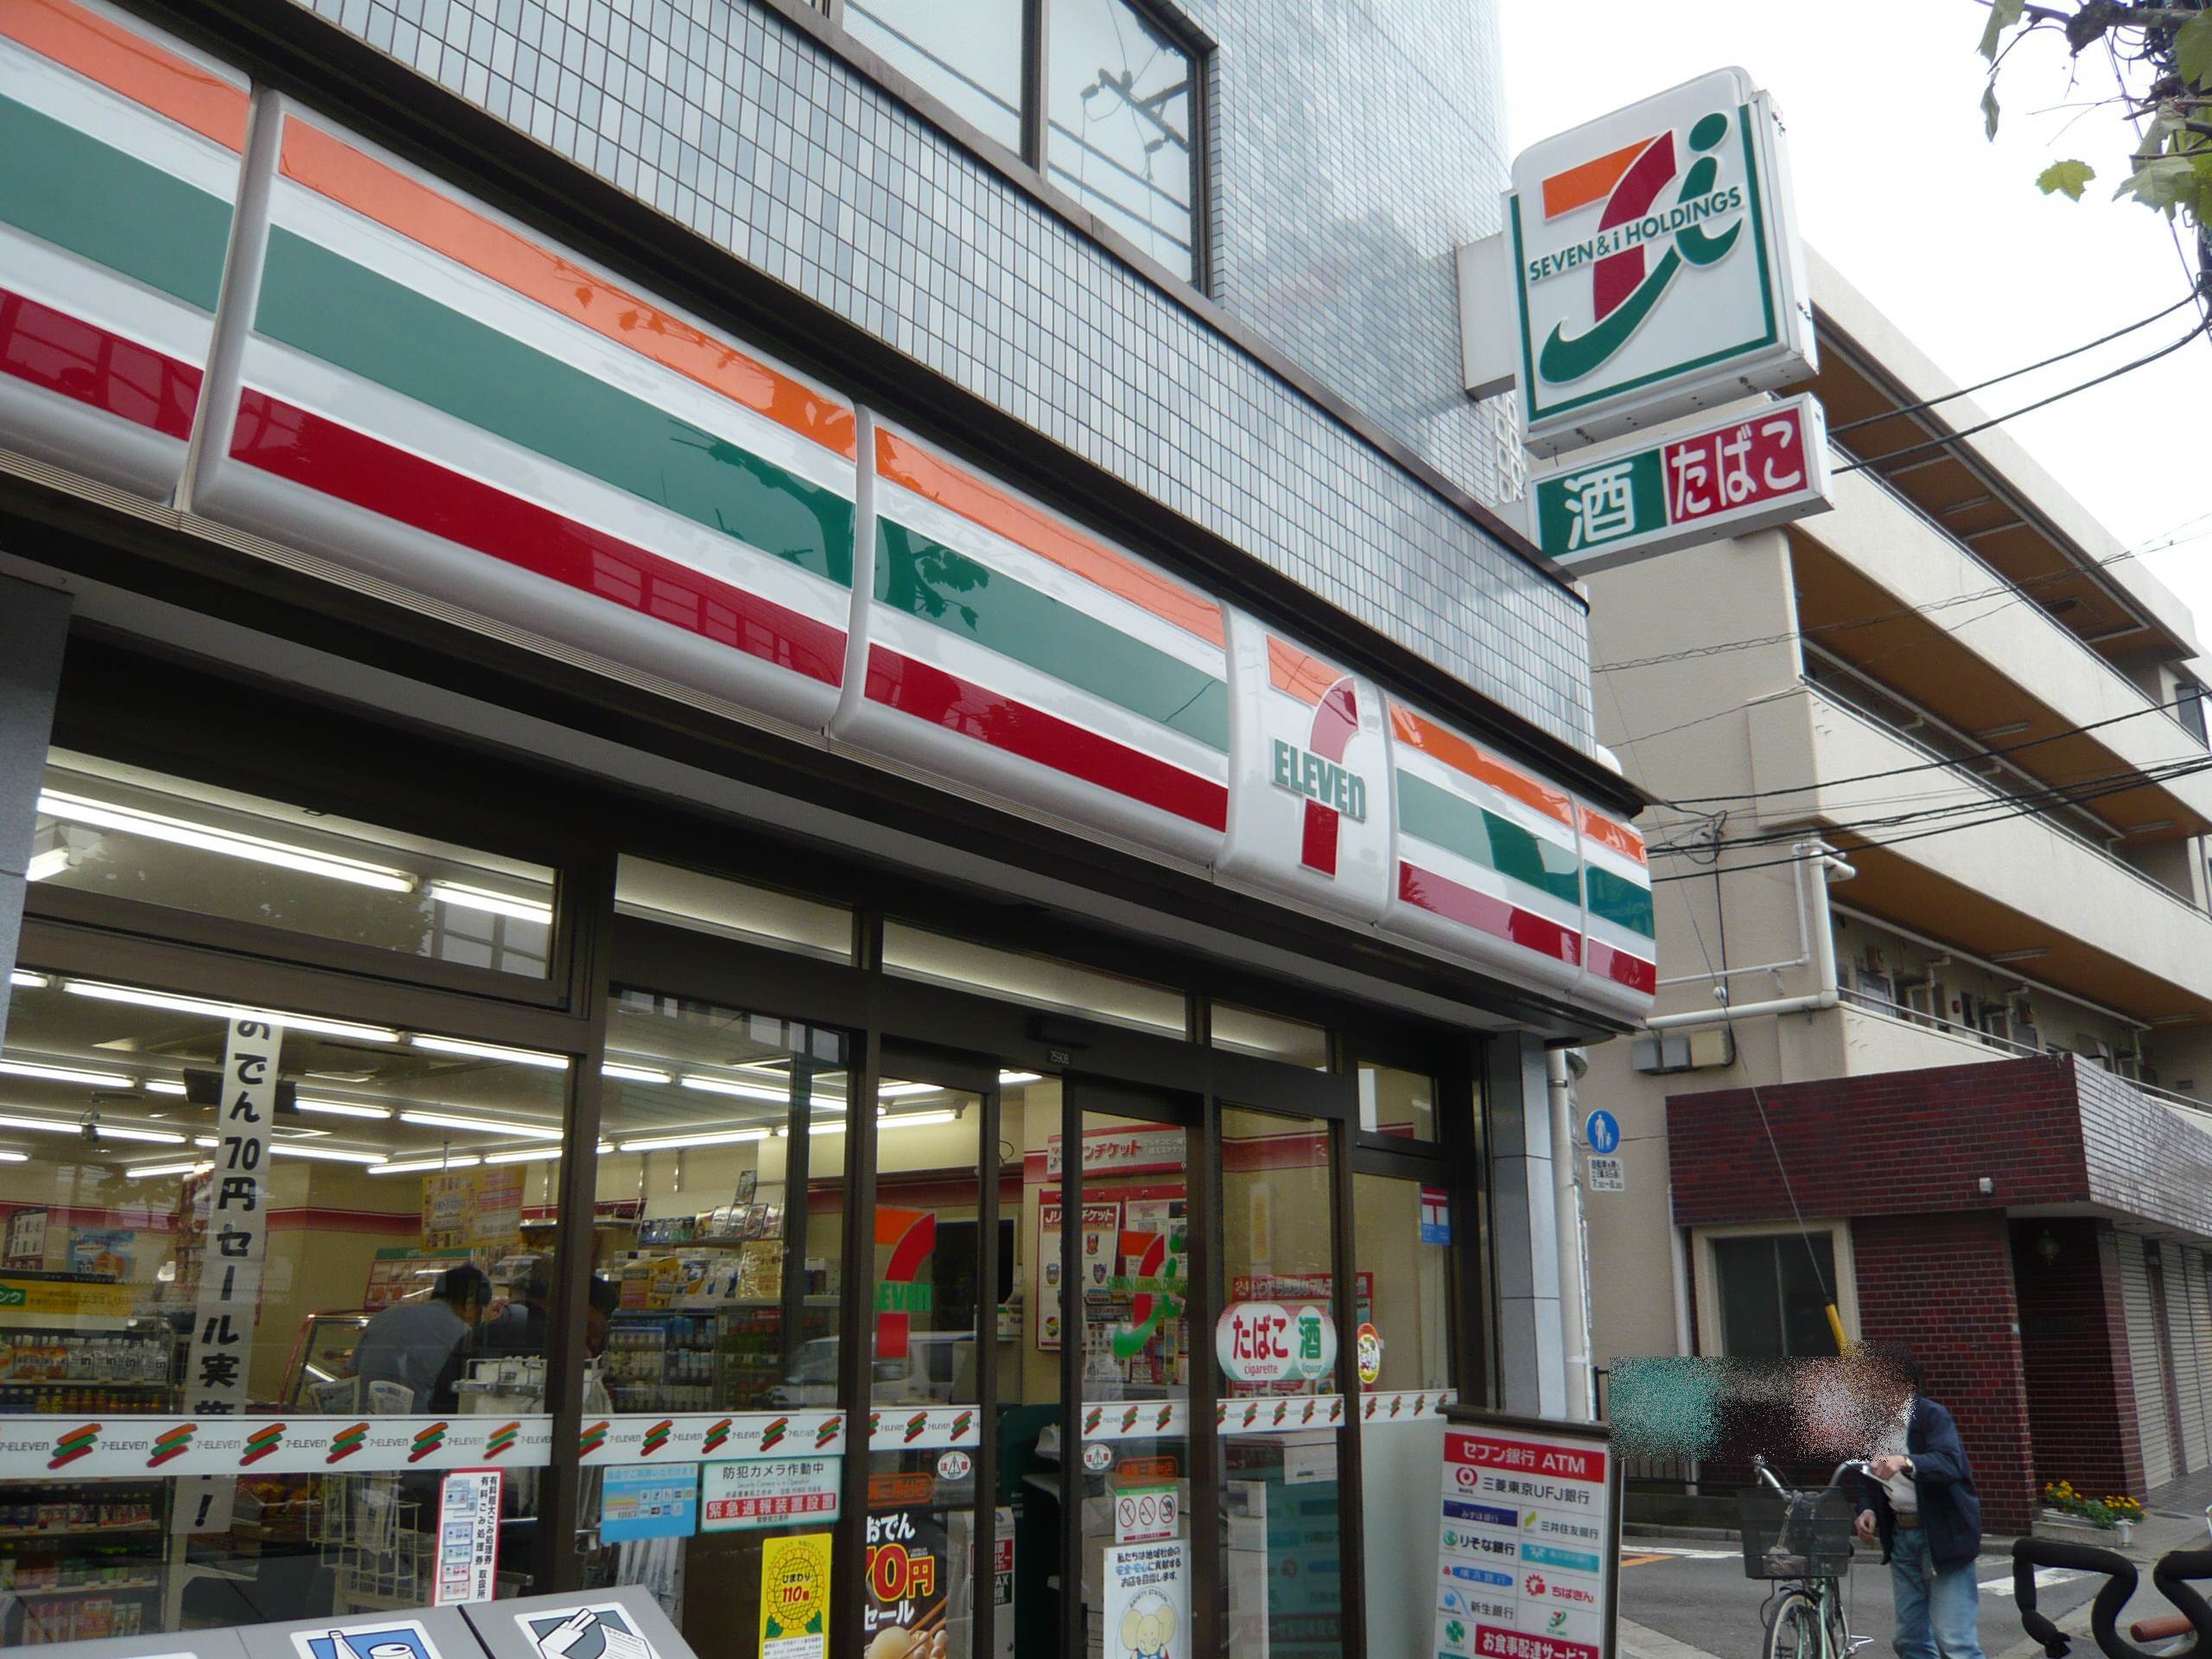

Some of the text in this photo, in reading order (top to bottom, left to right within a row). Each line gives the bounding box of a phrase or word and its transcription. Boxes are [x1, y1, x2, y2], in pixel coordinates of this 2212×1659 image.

[1529, 239, 1595, 283] SEVEN
[1596, 233, 1611, 256] &
[1625, 188, 1743, 243] HOLDINGS
[1564, 421, 1802, 550] 酒 たばこ
[1233, 1314, 1321, 1360] たばこ 酒
[1243, 1363, 1279, 1376] cigarette
[1463, 1440, 1586, 1474] セブン銀行 ATM
[722, 1462, 825, 1480] 防犯カメラ作動中
[1483, 1477, 1591, 1505] 三菱東京UFJ銀行
[709, 1494, 836, 1519] 緊急通報装置設置
[866, 1512, 916, 1543] おでん
[1541, 1521, 1599, 1540] 三井住友銀行
[1459, 1534, 1516, 1556] りそな銀行
[782, 1572, 811, 1584] ひまわり
[864, 1599, 915, 1631] セール
[1470, 1600, 1514, 1620] 新生銀行
